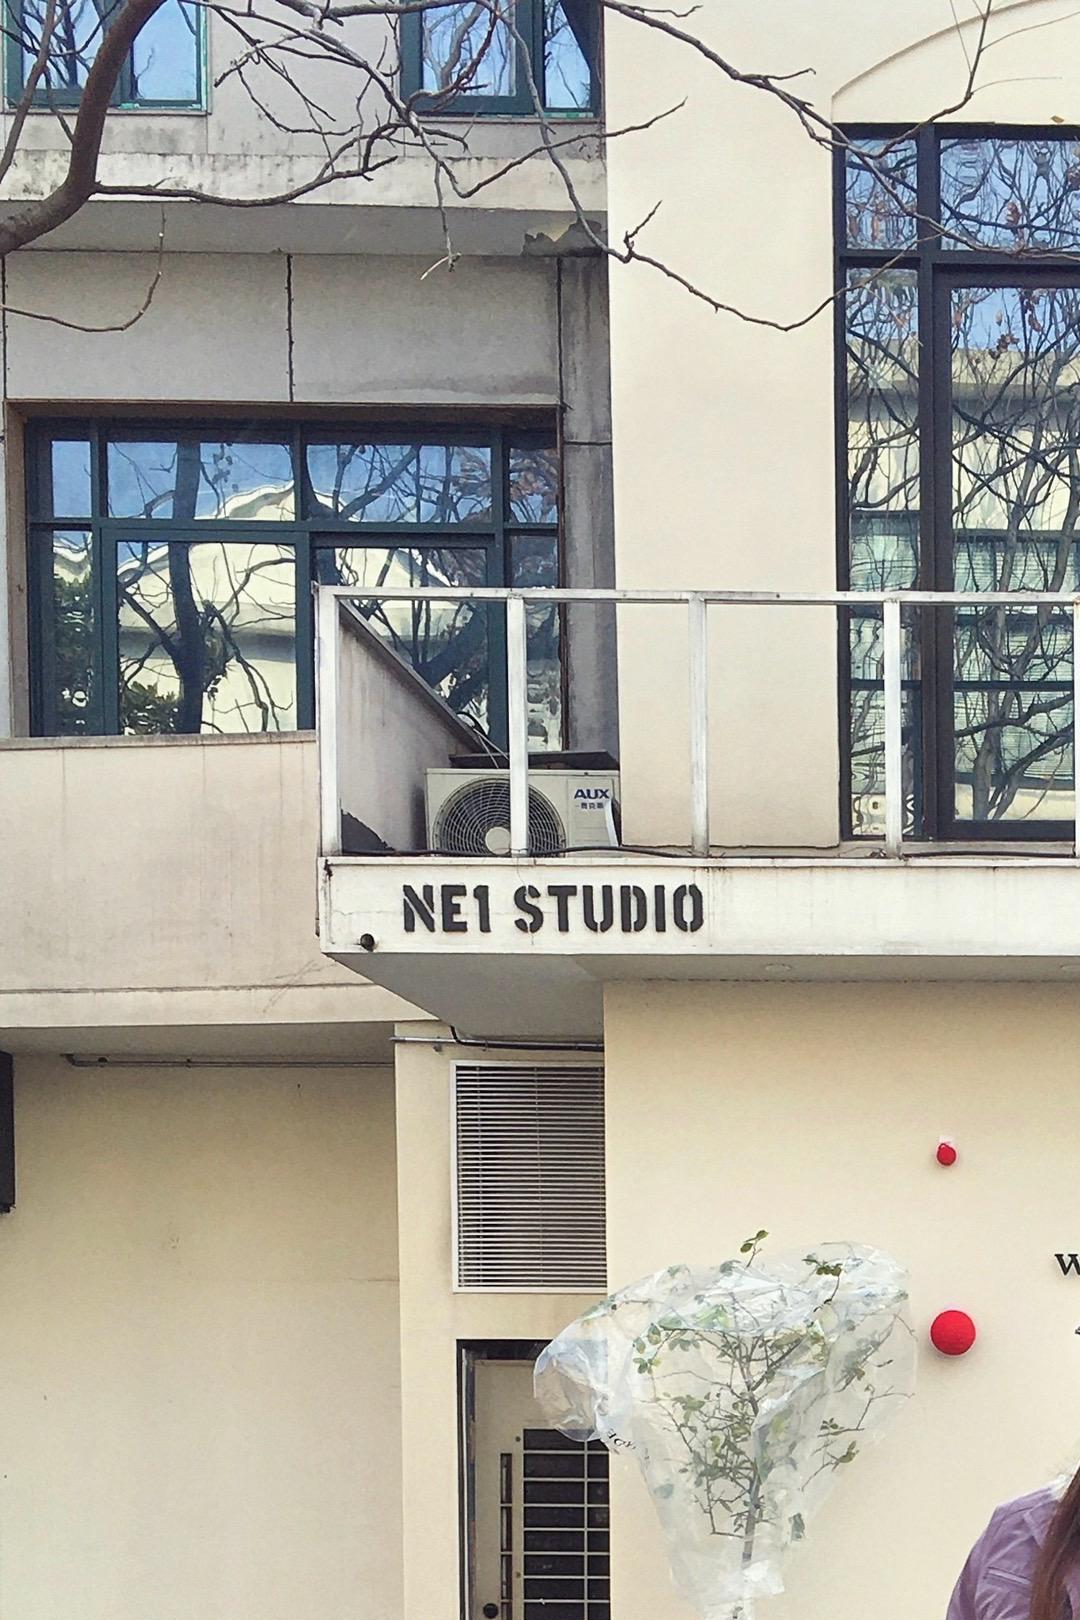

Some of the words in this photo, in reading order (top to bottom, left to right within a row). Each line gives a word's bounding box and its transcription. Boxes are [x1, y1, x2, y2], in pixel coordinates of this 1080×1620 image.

[574, 788, 610, 799] AUX
[402, 884, 492, 932] NE1
[514, 884, 704, 932] STUDIO
